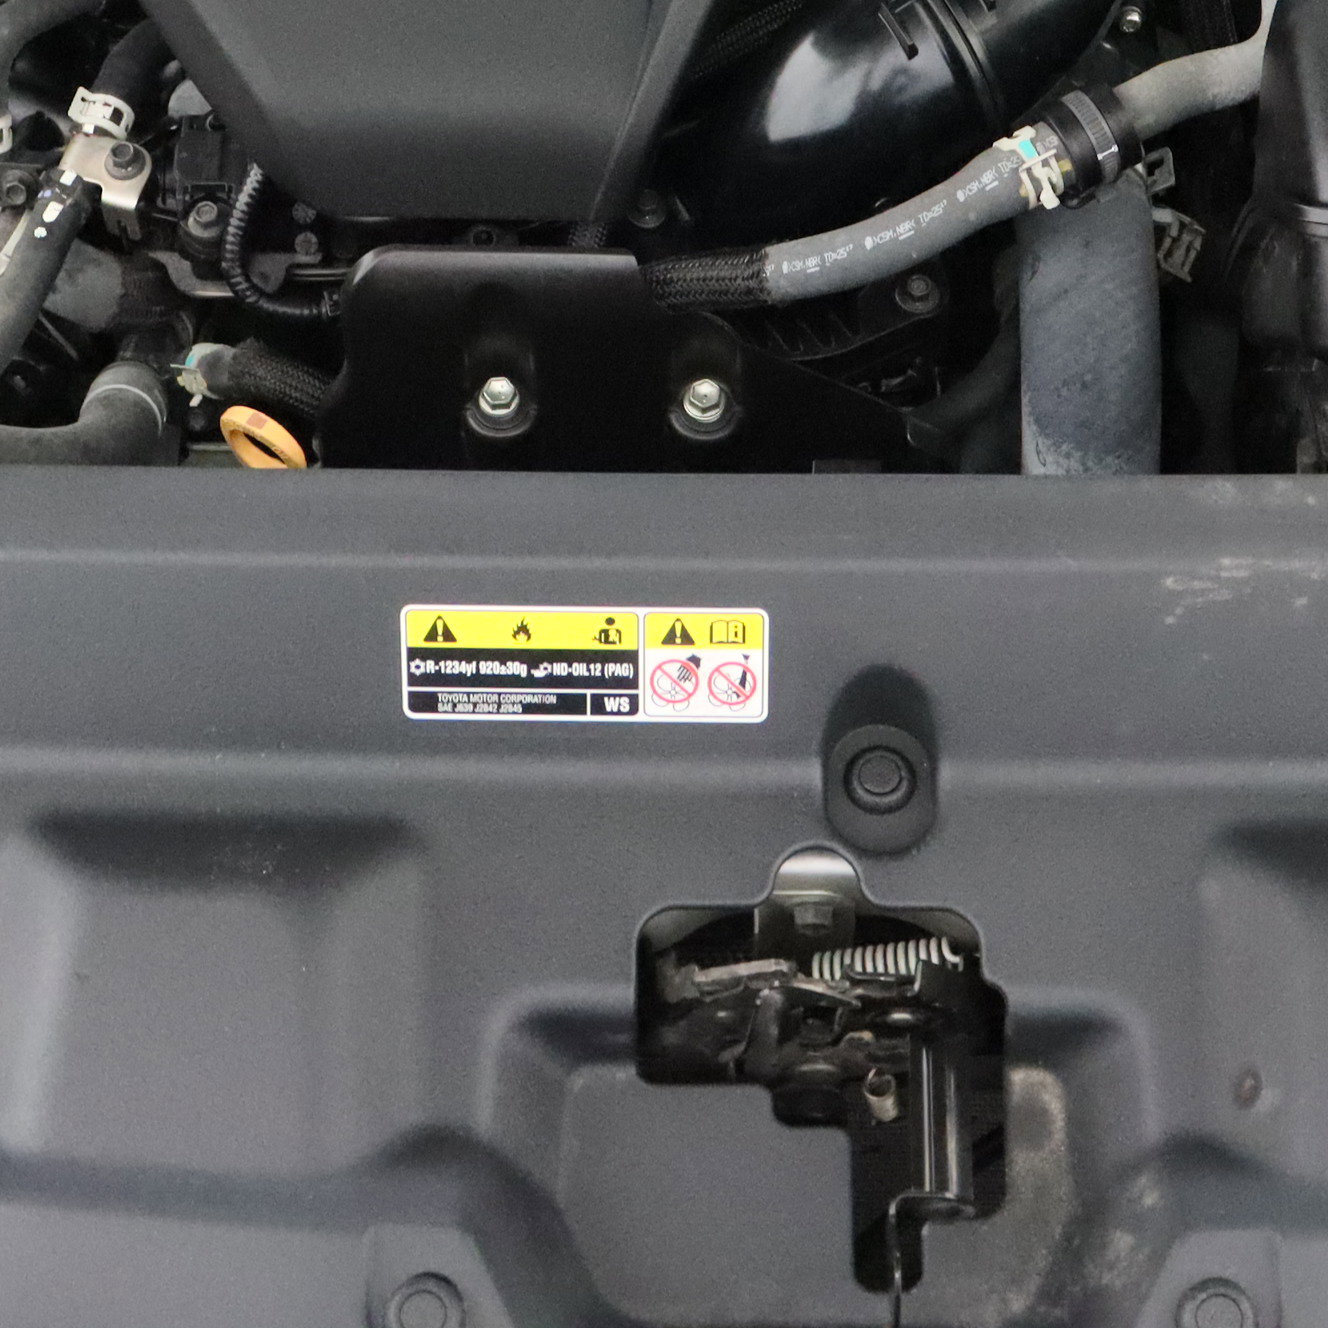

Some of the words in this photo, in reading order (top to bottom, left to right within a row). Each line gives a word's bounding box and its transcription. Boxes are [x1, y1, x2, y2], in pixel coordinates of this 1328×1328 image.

[425, 660, 476, 676] R-1234yf
[604, 662, 634, 678] (PAG)
[438, 692, 468, 703] TOYOTA
[470, 693, 498, 703] MOTOR
[500, 693, 557, 704] CORPORATION
[604, 697, 630, 713] WS
[437, 703, 453, 712] SAE
[455, 703, 472, 712] J639
[474, 703, 497, 713] J2842
[499, 704, 522, 713] J2845
